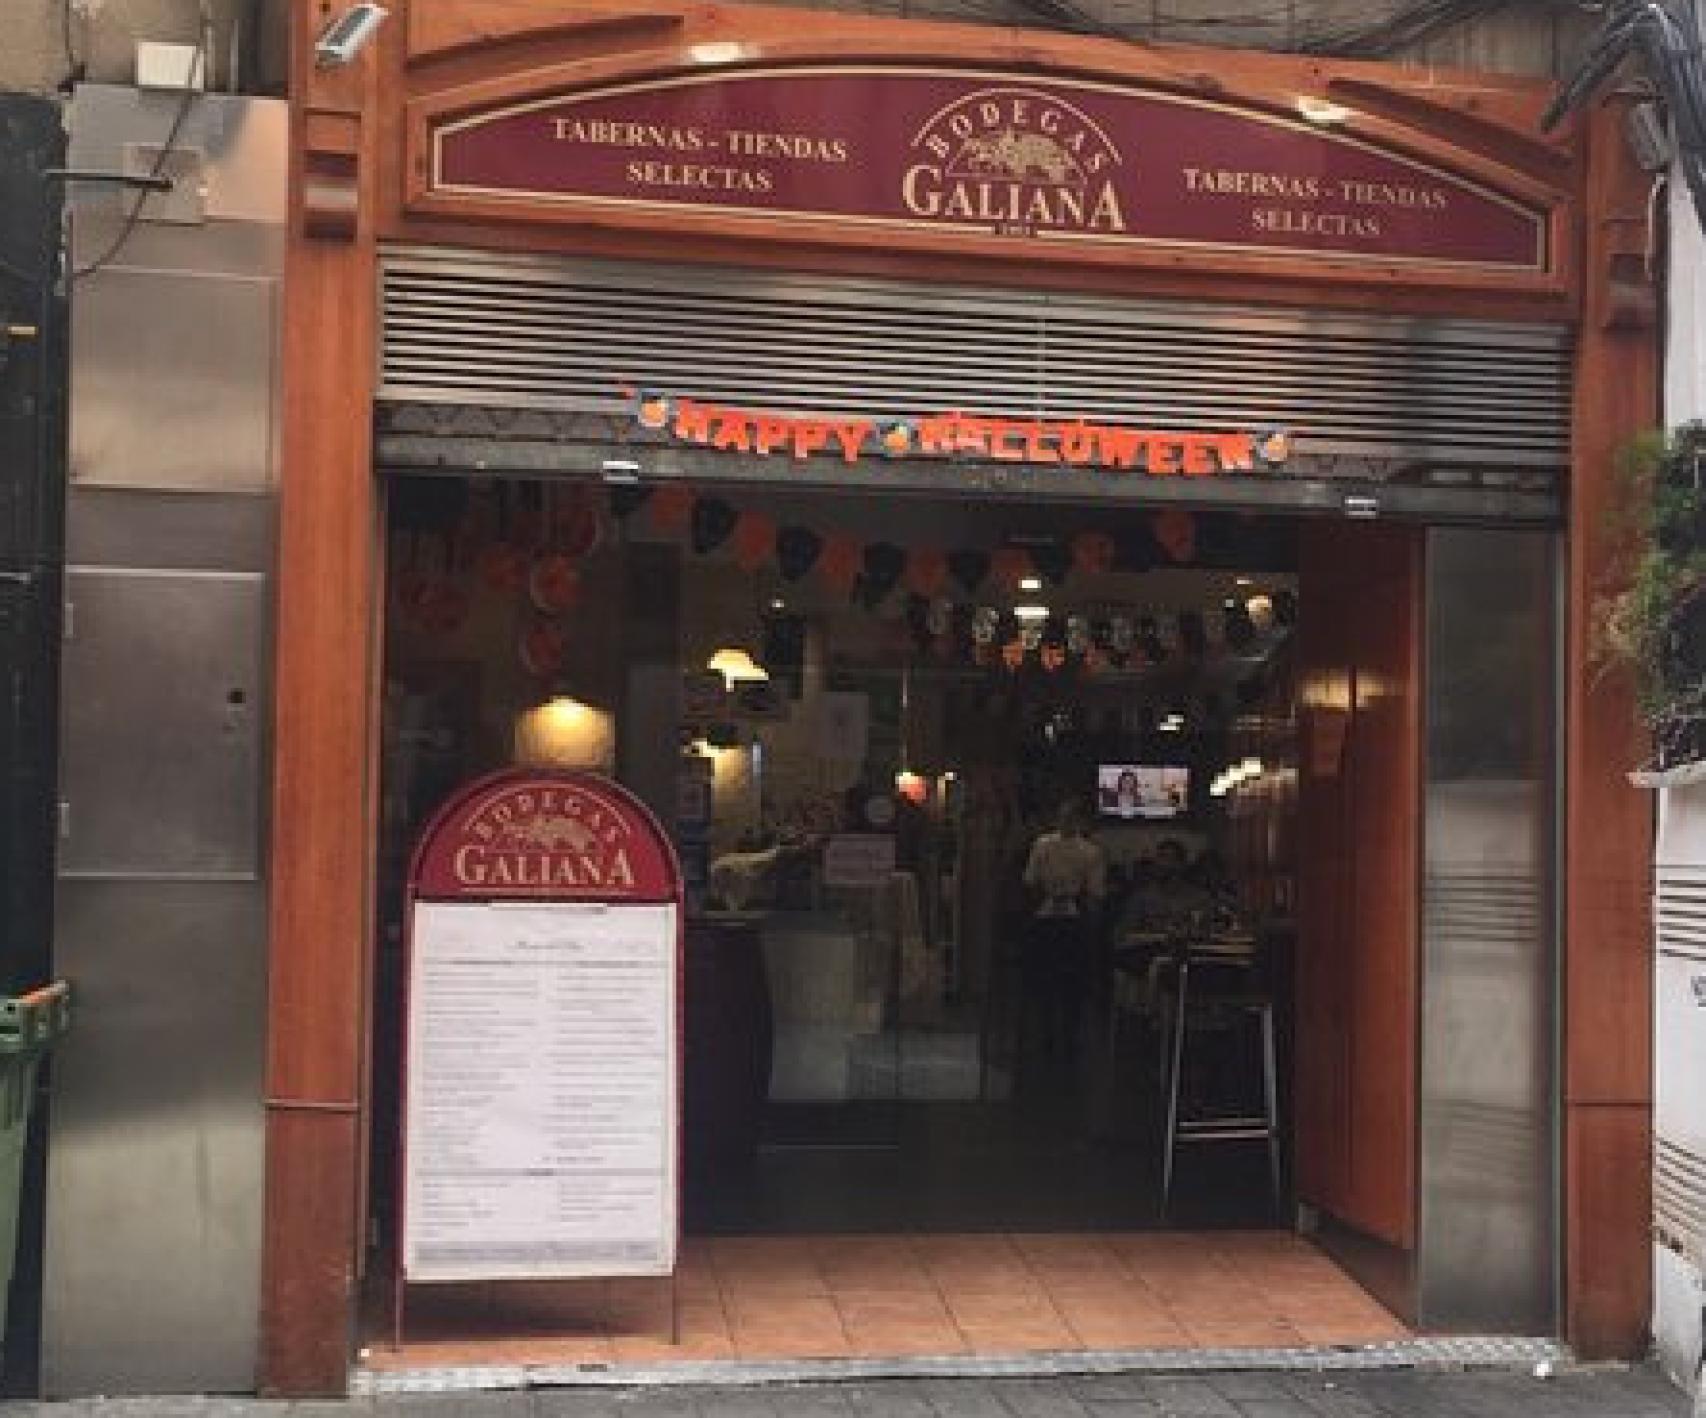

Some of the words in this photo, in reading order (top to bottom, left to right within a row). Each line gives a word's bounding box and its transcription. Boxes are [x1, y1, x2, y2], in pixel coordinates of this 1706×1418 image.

[551, 117, 705, 151] TABERNAS
[727, 129, 847, 163] TIENDAS
[924, 98, 1104, 174] BODEGAS
[626, 161, 774, 193] SELECTAS
[902, 164, 1127, 232] GALIANA
[1182, 167, 1320, 198] TABERNAS
[1339, 179, 1447, 209] TIENDAS
[1251, 207, 1381, 236] SELECTAS
[675, 396, 872, 463] HAPPY
[916, 411, 1253, 475] HALLOWEEN
[455, 845, 636, 885] GALIANA
